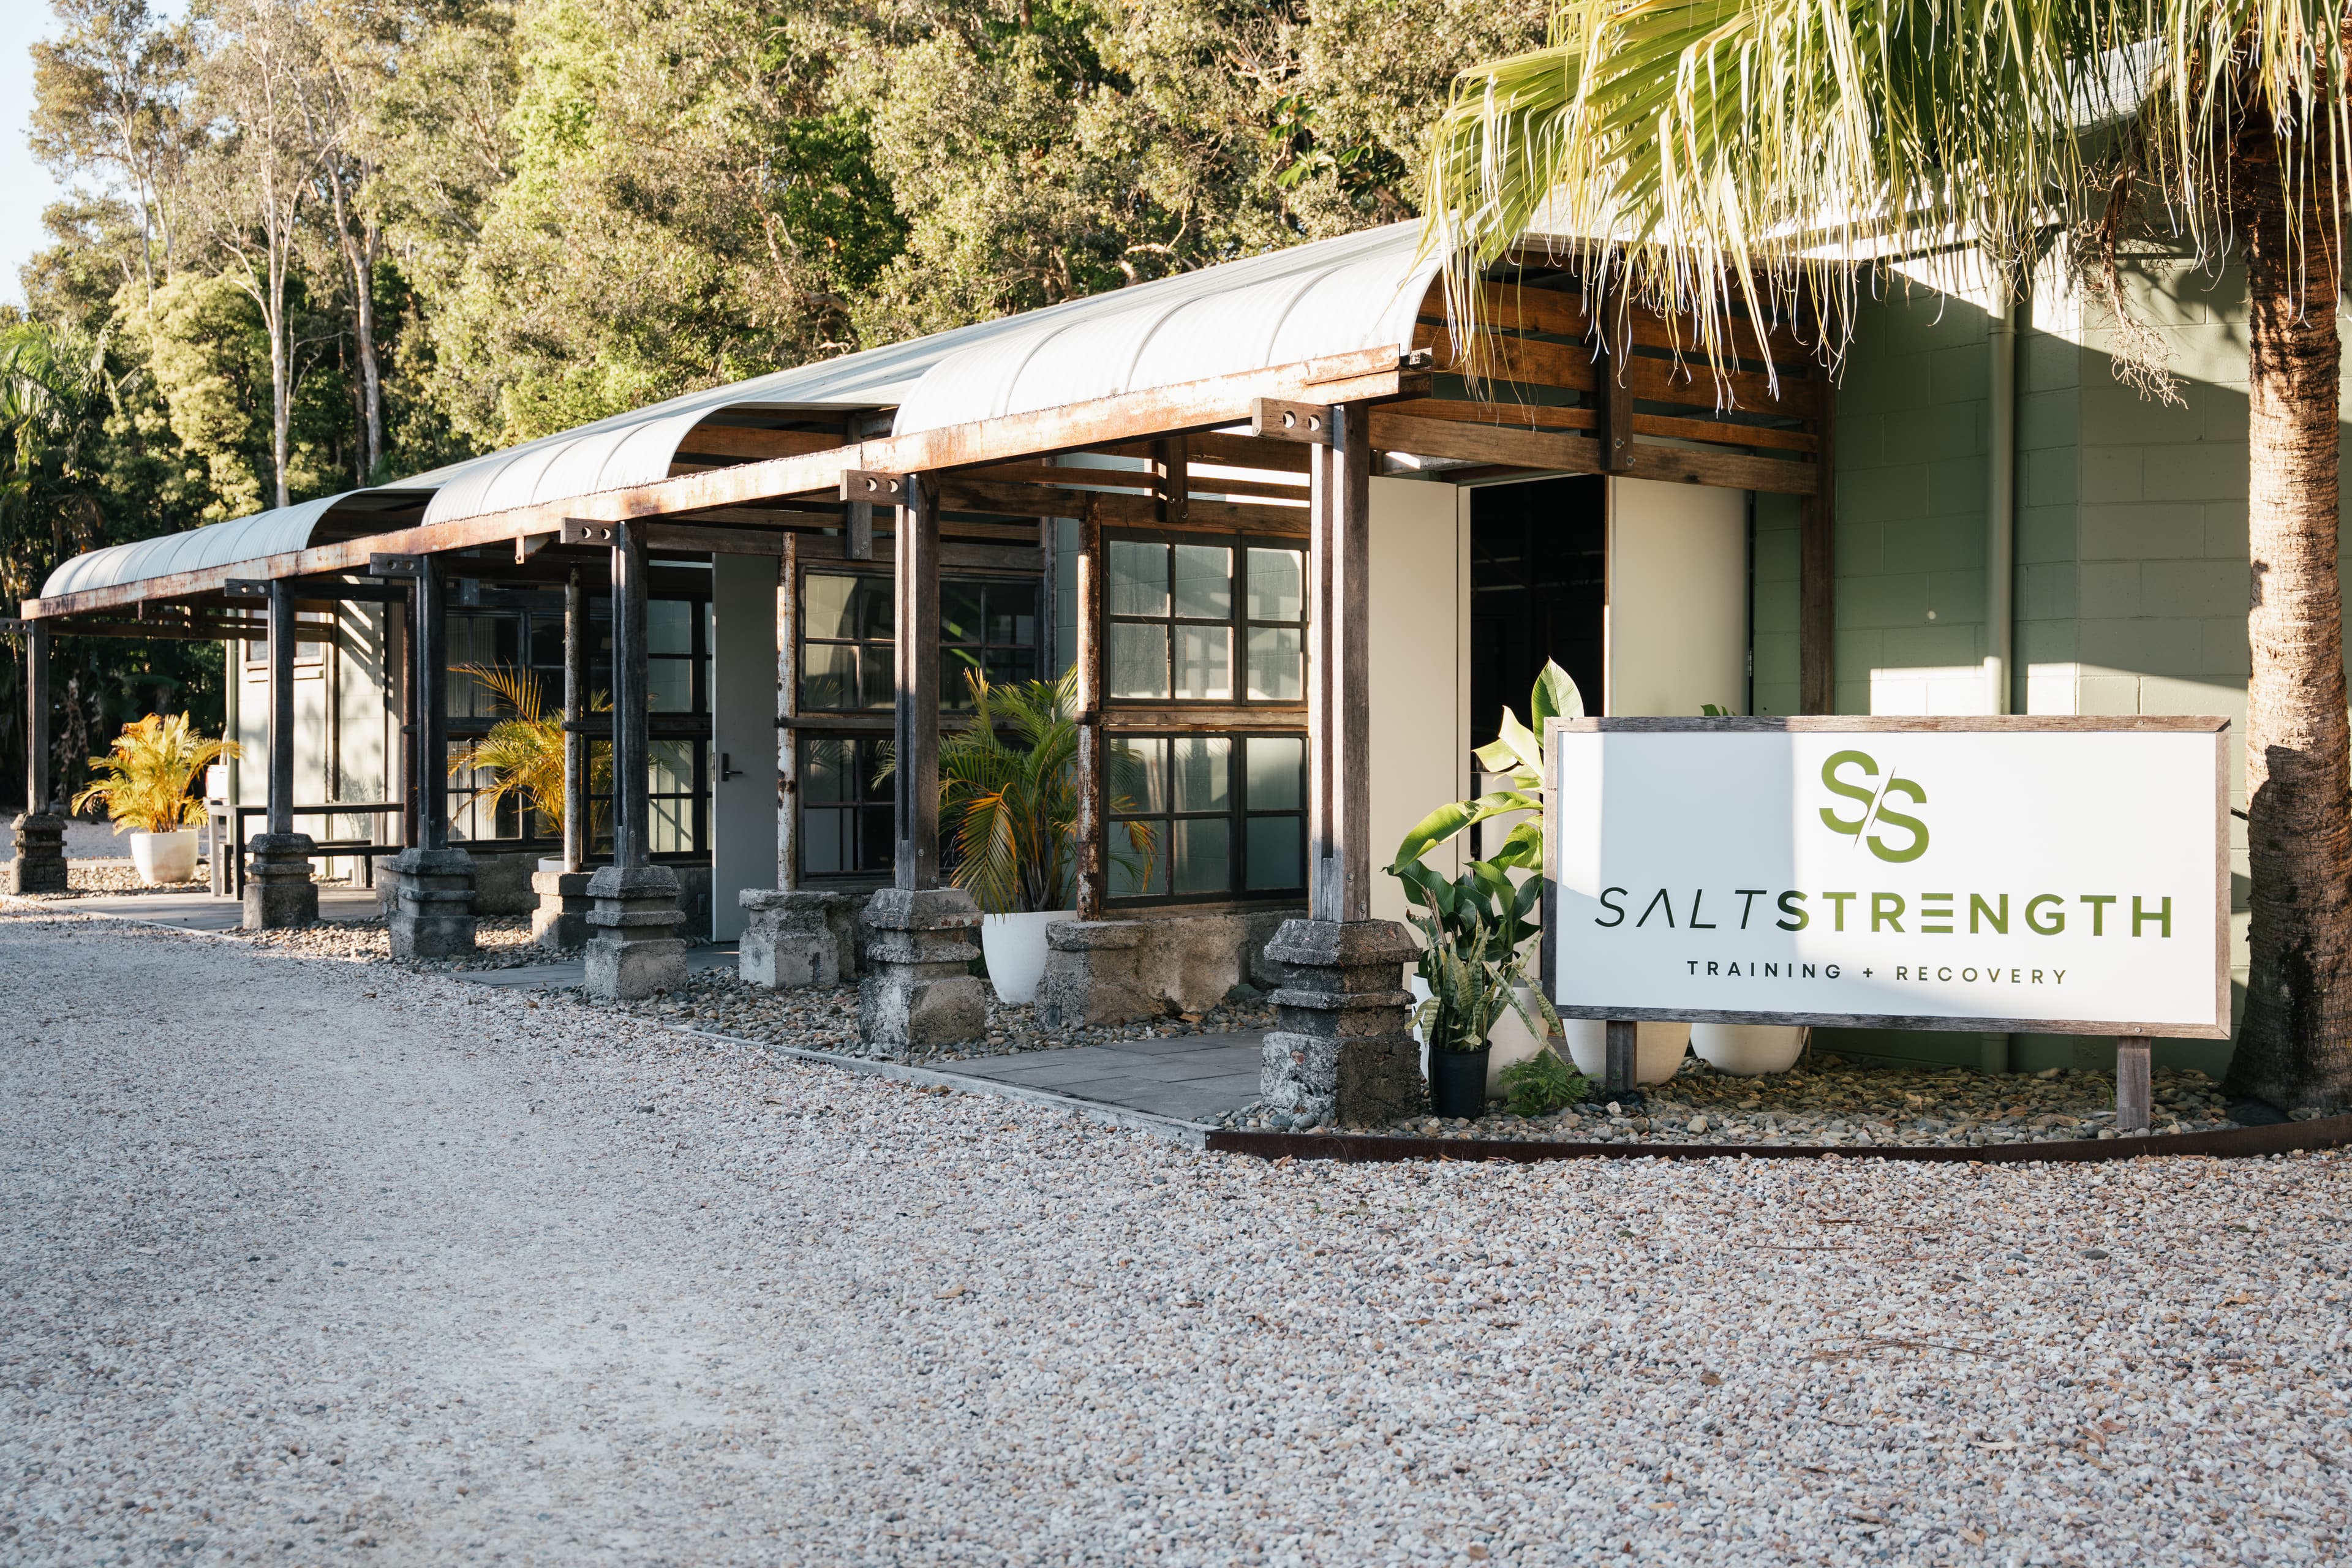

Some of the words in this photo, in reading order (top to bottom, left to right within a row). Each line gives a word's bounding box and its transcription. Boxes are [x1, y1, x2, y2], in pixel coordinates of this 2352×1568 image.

[1686, 960, 1841, 979] TRAINING
[1862, 968, 1873, 978] +
[1896, 966, 2066, 984] RECOVERY
